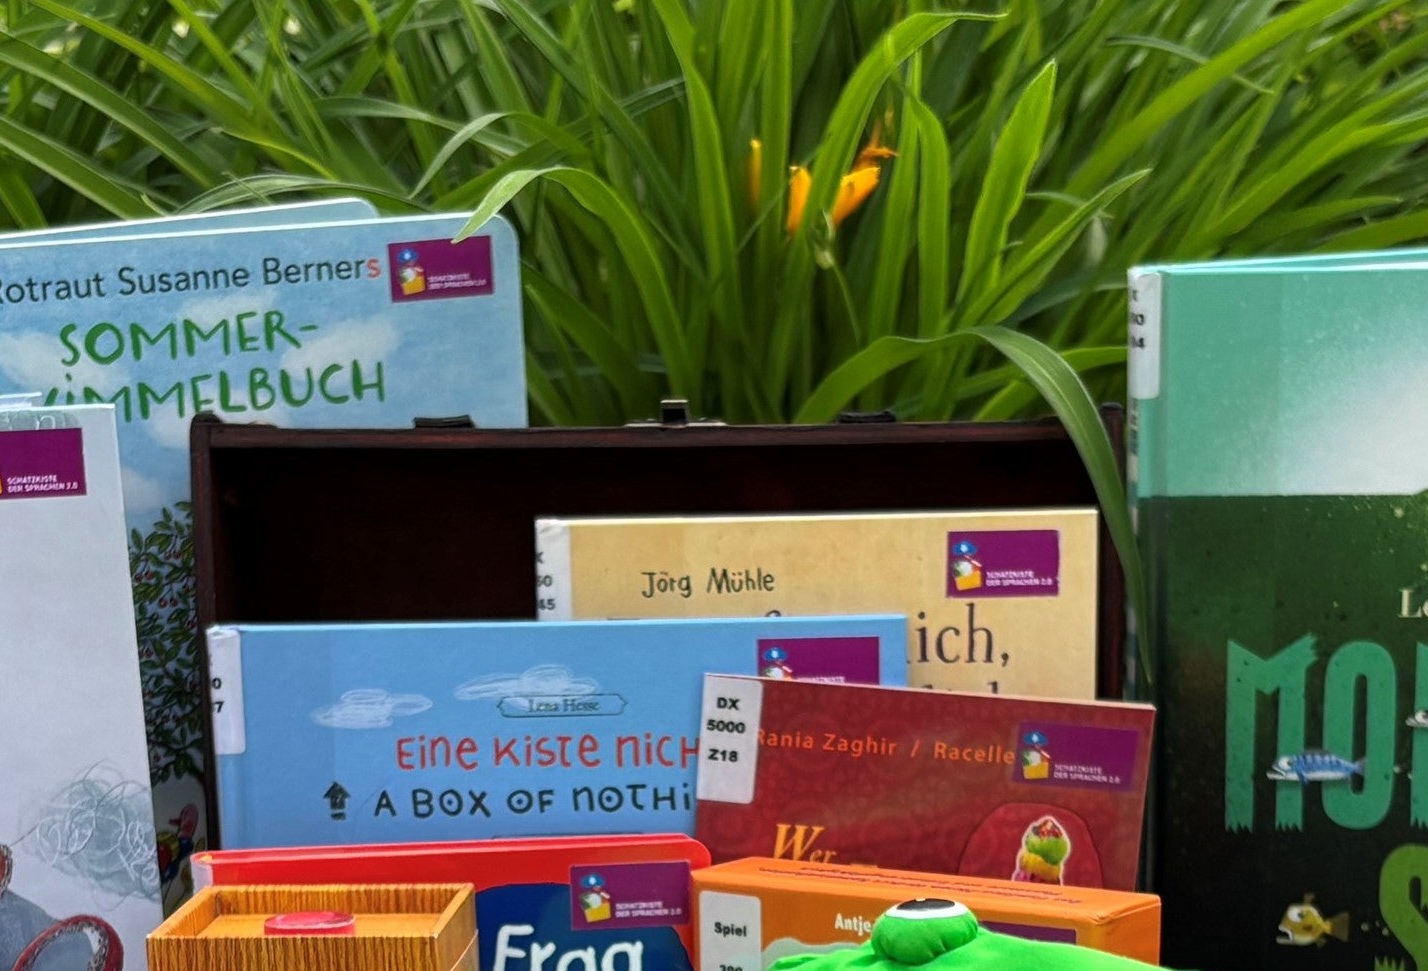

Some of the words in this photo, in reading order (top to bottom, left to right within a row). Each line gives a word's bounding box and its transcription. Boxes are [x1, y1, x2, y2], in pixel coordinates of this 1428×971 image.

[118, 264, 249, 297] Susanne
[264, 255, 382, 286] Berners
[60, 310, 318, 368] SOMMER-
[641, 570, 692, 598] Jörg
[707, 566, 774, 594] Mühle
[906, 602, 1009, 667] ich,
[716, 698, 740, 711] DX
[706, 720, 746, 735] 5000
[708, 749, 739, 763] Z18
[757, 728, 813, 750] Rania
[822, 732, 898, 757] Zaghir
[934, 741, 1015, 765] Racelle
[374, 790, 396, 817] A
[412, 788, 490, 819] BOX
[507, 789, 554, 814] OF
[714, 922, 747, 938] Spiel
[835, 913, 873, 936] Antje
